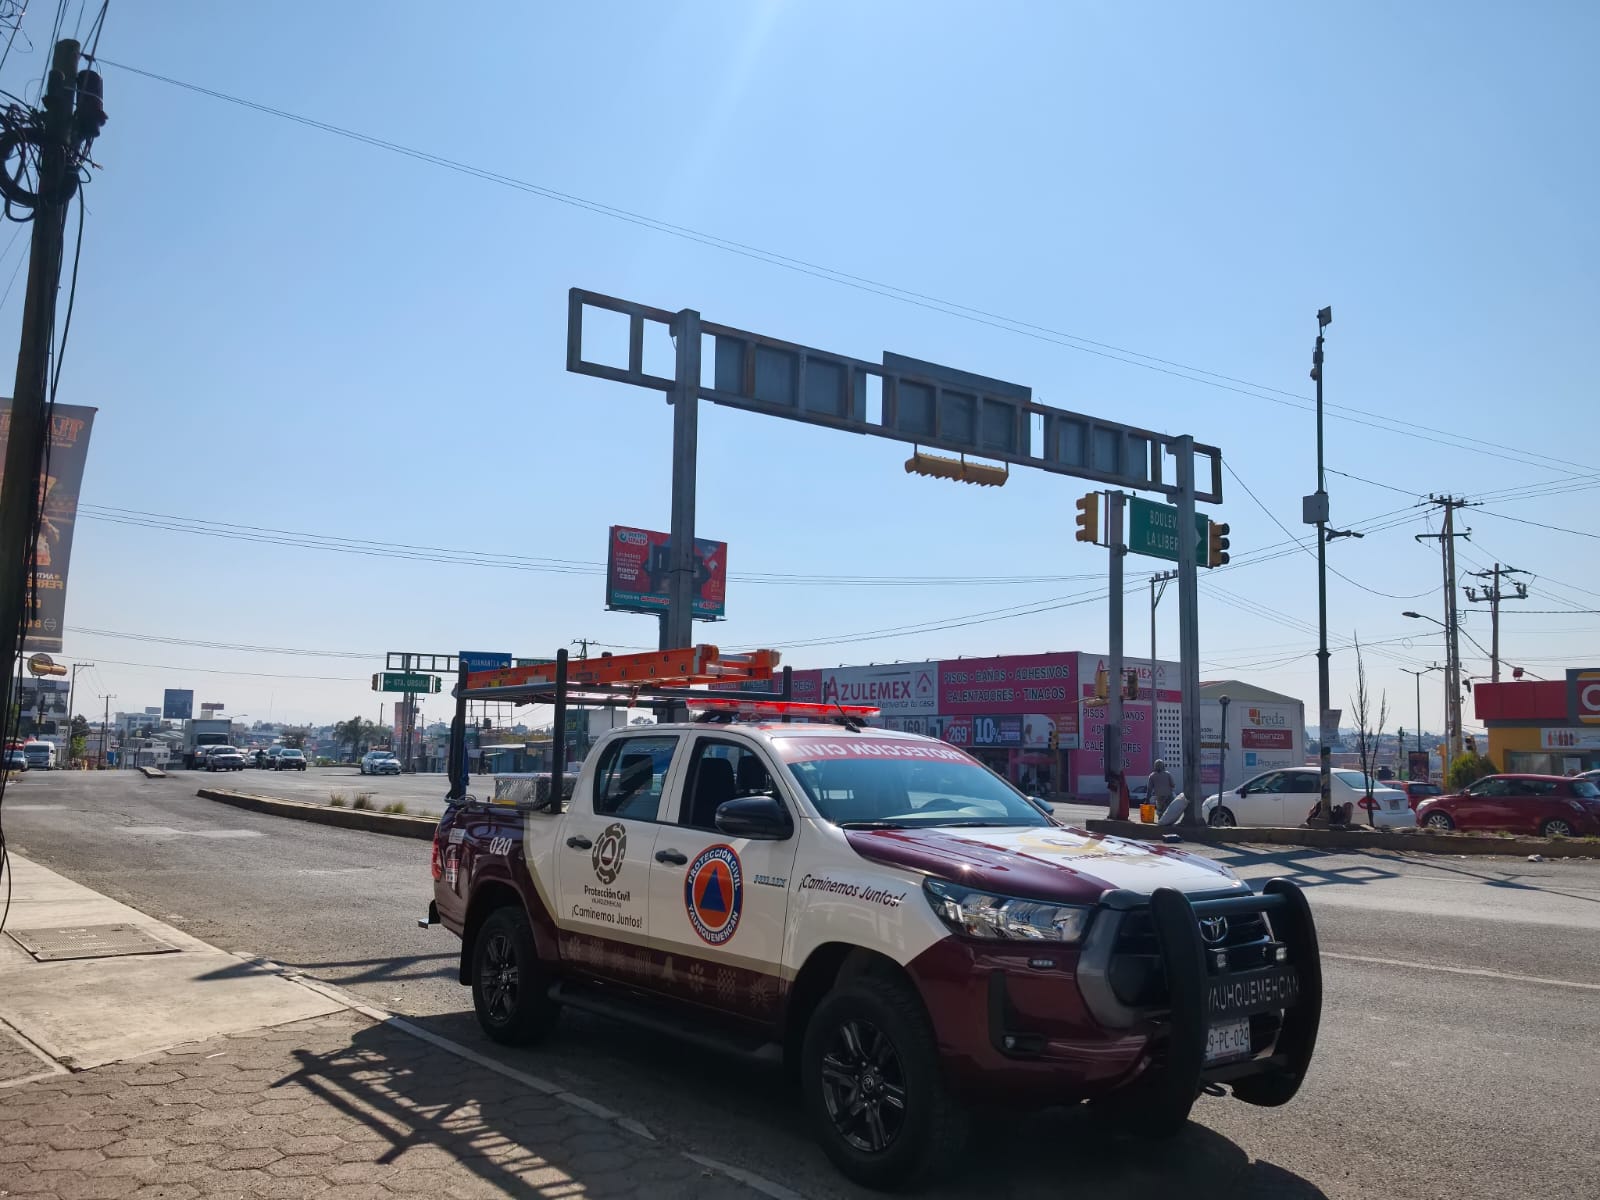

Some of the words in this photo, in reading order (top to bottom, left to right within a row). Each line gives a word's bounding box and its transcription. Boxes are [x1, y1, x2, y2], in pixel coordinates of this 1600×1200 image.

[1150, 510, 1177, 528] BOULEV
[1158, 533, 1179, 551] LIBER
[944, 671, 968, 684] PISOS
[1015, 664, 1070, 680] ADHESIVOS
[826, 676, 911, 701] AZULEMEX
[946, 688, 1014, 702] CALENTADORES
[1024, 687, 1066, 700] TINACOS
[1083, 708, 1105, 719] PISOS
[489, 837, 513, 856] 020
[688, 848, 732, 884] PROTECCIÓN
[730, 861, 741, 890] CIVIL
[584, 885, 617, 900] Protección
[617, 890, 631, 902] Civil
[798, 873, 859, 897] ¡Caminemos
[859, 885, 907, 908] Juntos!
[572, 904, 615, 924] ¡Caminemos
[616, 913, 643, 929] Juntos!
